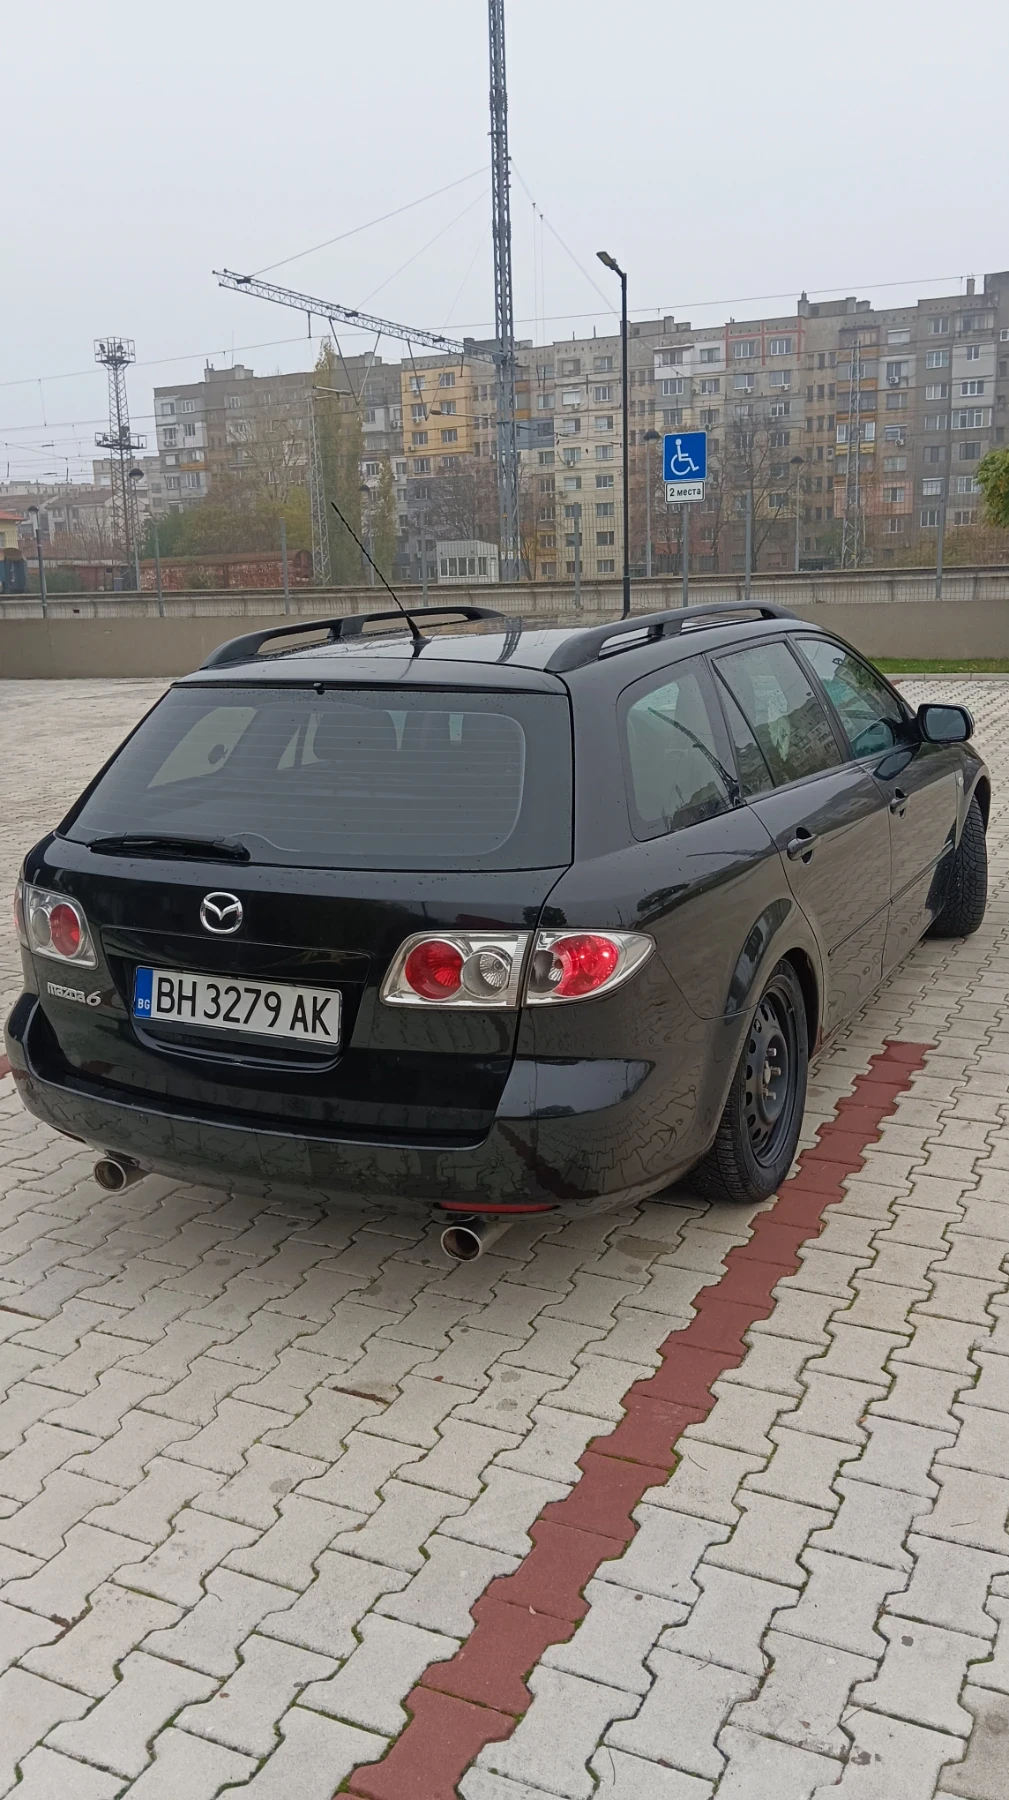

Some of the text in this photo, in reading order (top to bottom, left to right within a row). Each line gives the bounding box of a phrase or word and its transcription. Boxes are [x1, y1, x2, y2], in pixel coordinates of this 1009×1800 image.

[669, 487, 701, 497] 2 места
[137, 998, 150, 1010] BG
[156, 977, 331, 1036] BH 3279 AK
